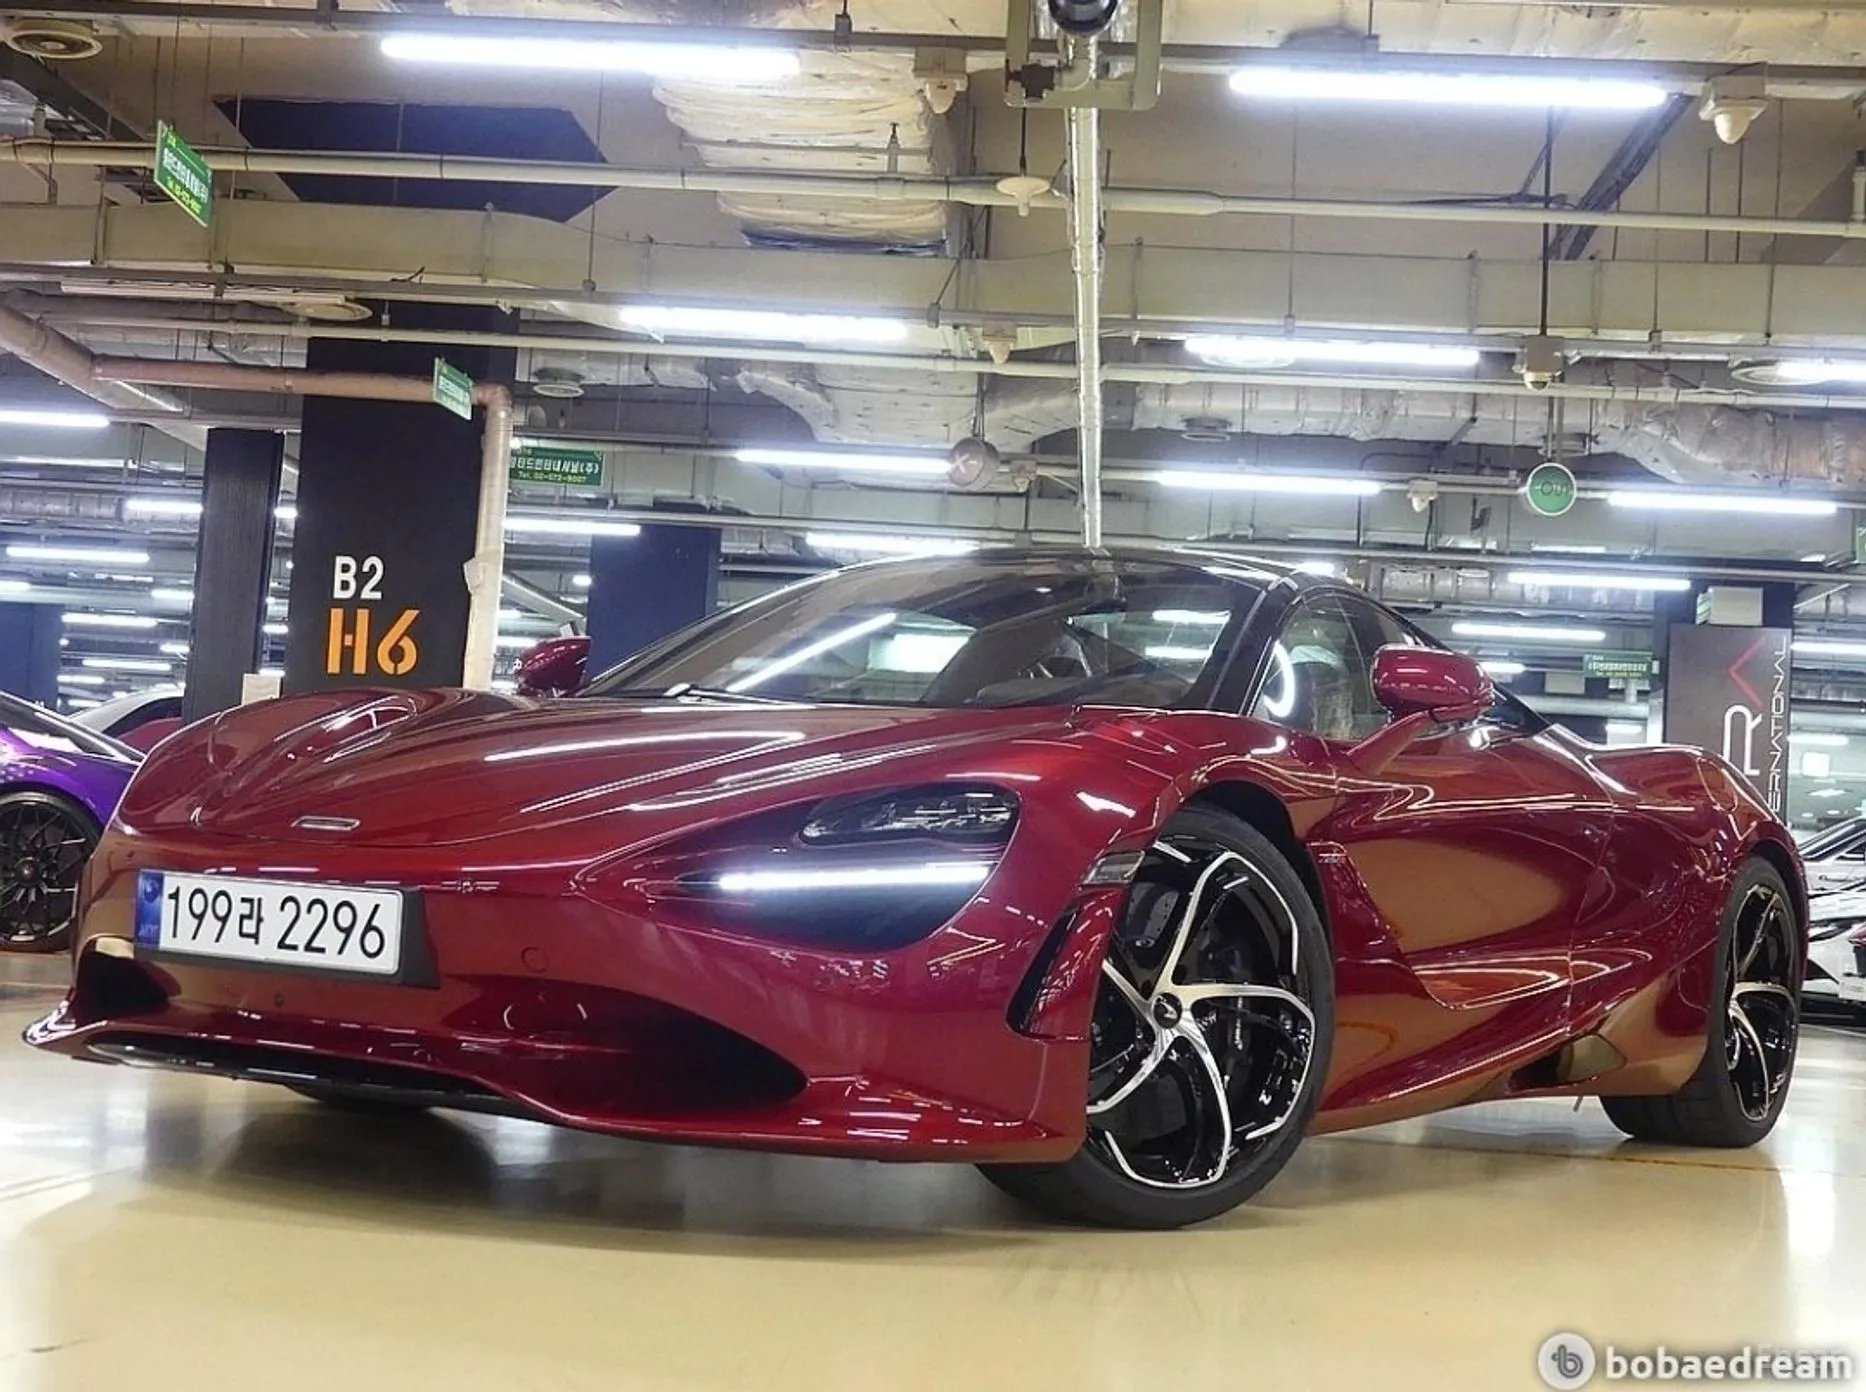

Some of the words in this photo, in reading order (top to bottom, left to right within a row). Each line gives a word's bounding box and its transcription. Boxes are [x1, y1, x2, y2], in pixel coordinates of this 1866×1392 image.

[333, 555, 384, 600] B2
[327, 607, 420, 675] H6
[167, 885, 264, 945] 199라
[276, 895, 386, 960] 2296
